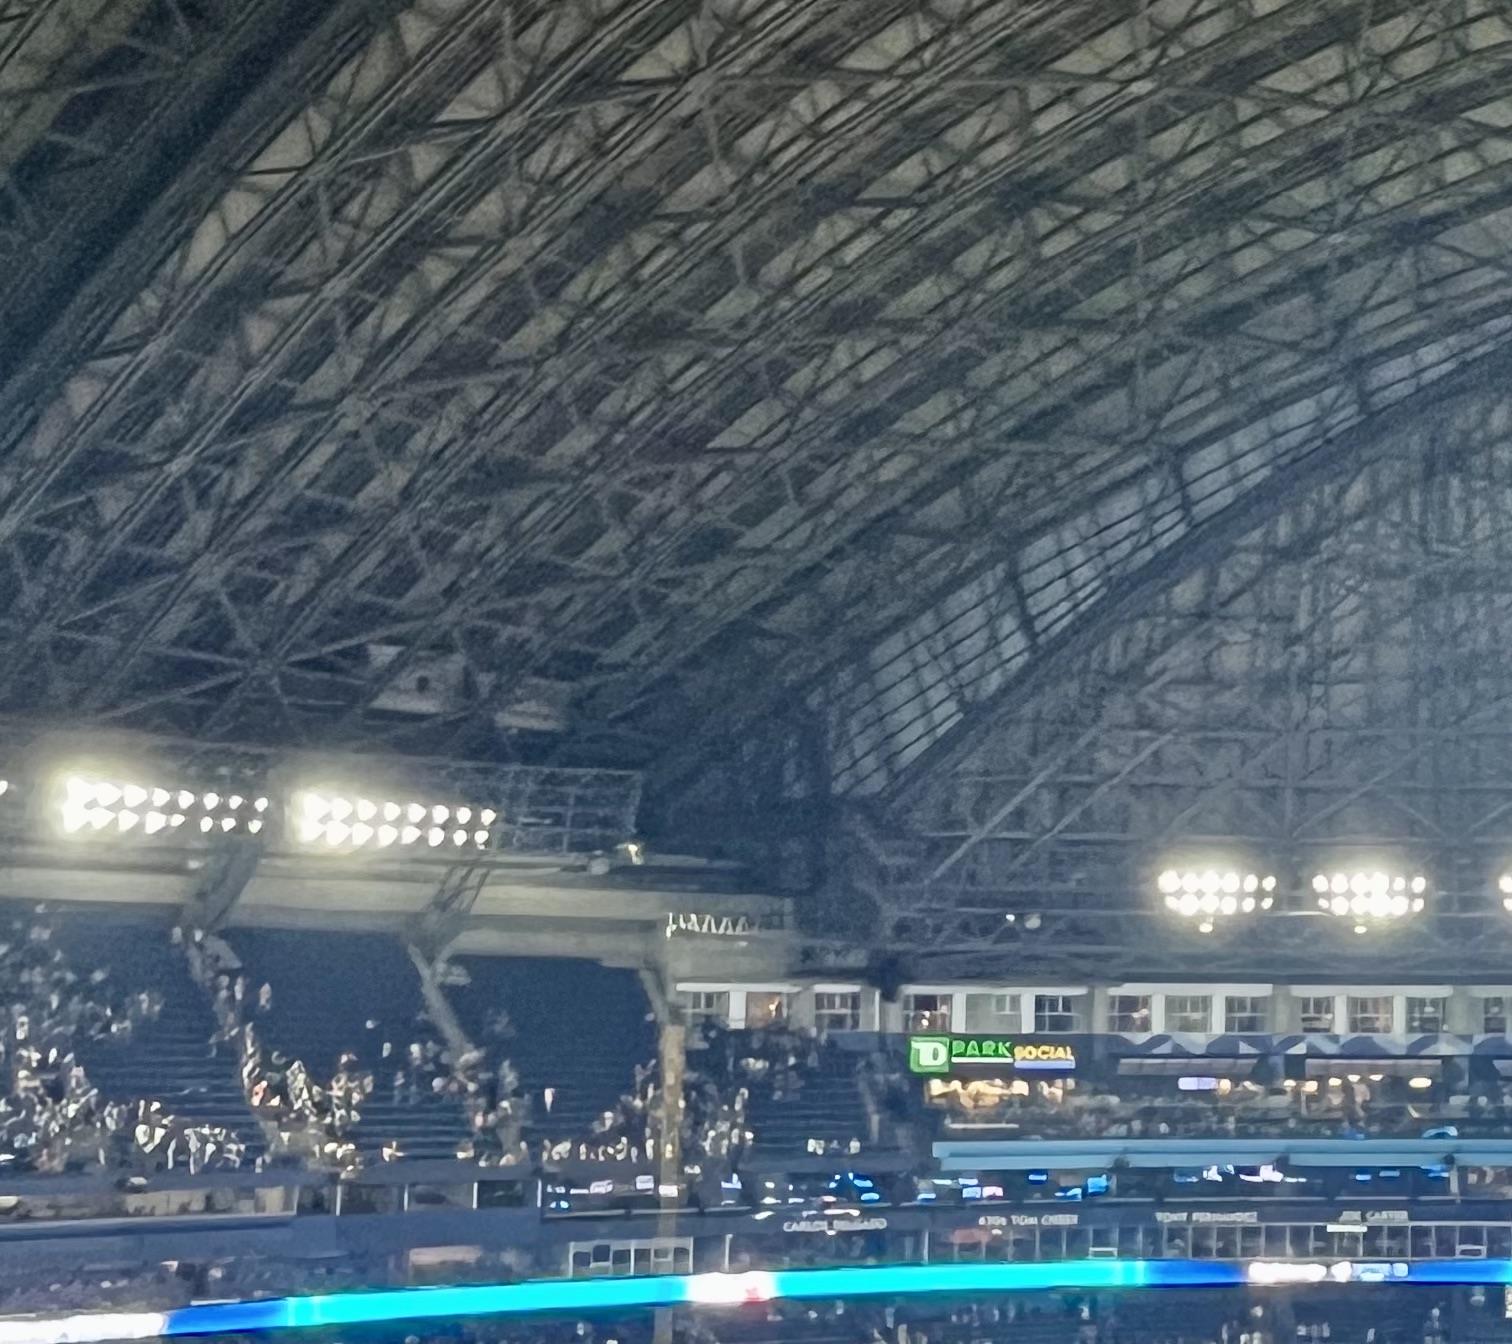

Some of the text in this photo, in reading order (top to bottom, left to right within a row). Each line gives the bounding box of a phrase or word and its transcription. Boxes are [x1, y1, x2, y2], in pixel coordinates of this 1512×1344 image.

[911, 1040, 1075, 1066] TD PARK SOCIAL
